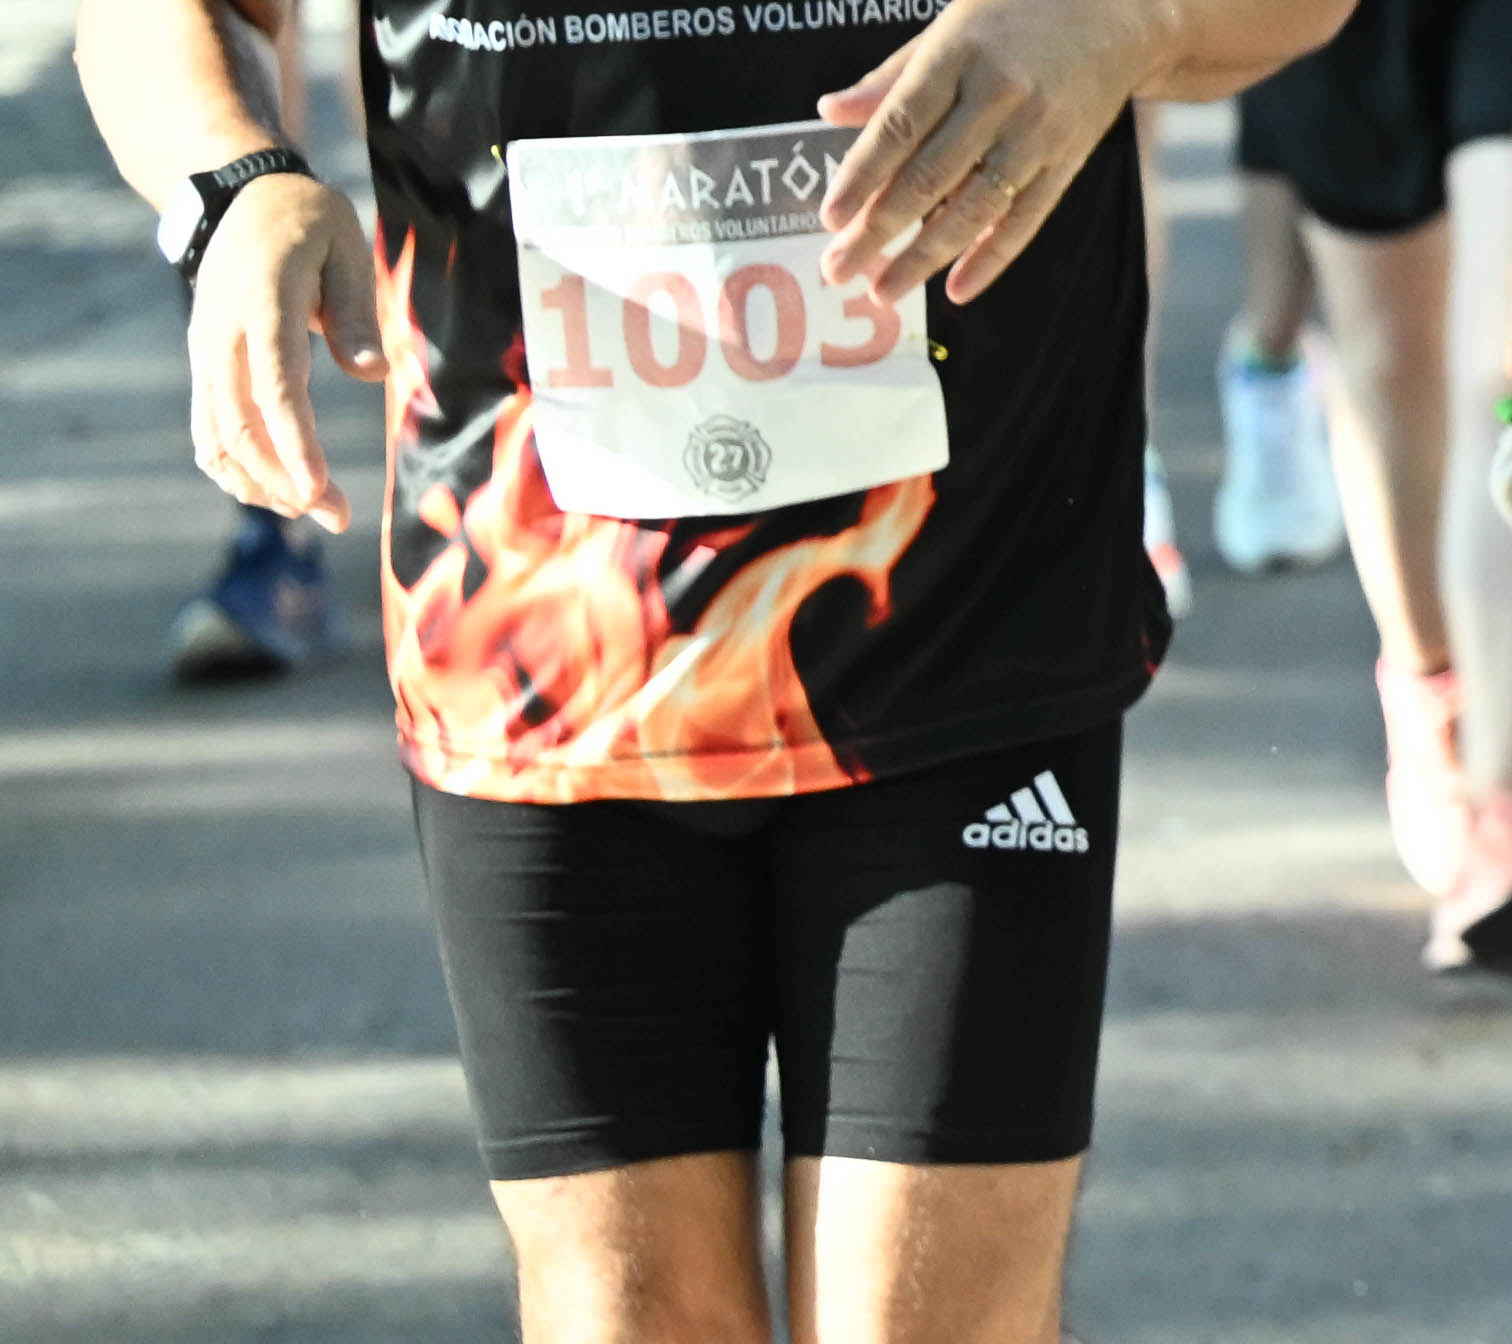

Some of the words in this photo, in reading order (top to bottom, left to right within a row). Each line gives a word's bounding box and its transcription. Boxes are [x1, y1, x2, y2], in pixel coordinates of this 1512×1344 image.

[564, 6, 736, 44] BOMBEROS
[715, 210, 819, 241] VOLUNTARIO
[540, 263, 902, 390] 1003
[709, 443, 744, 473] 27
